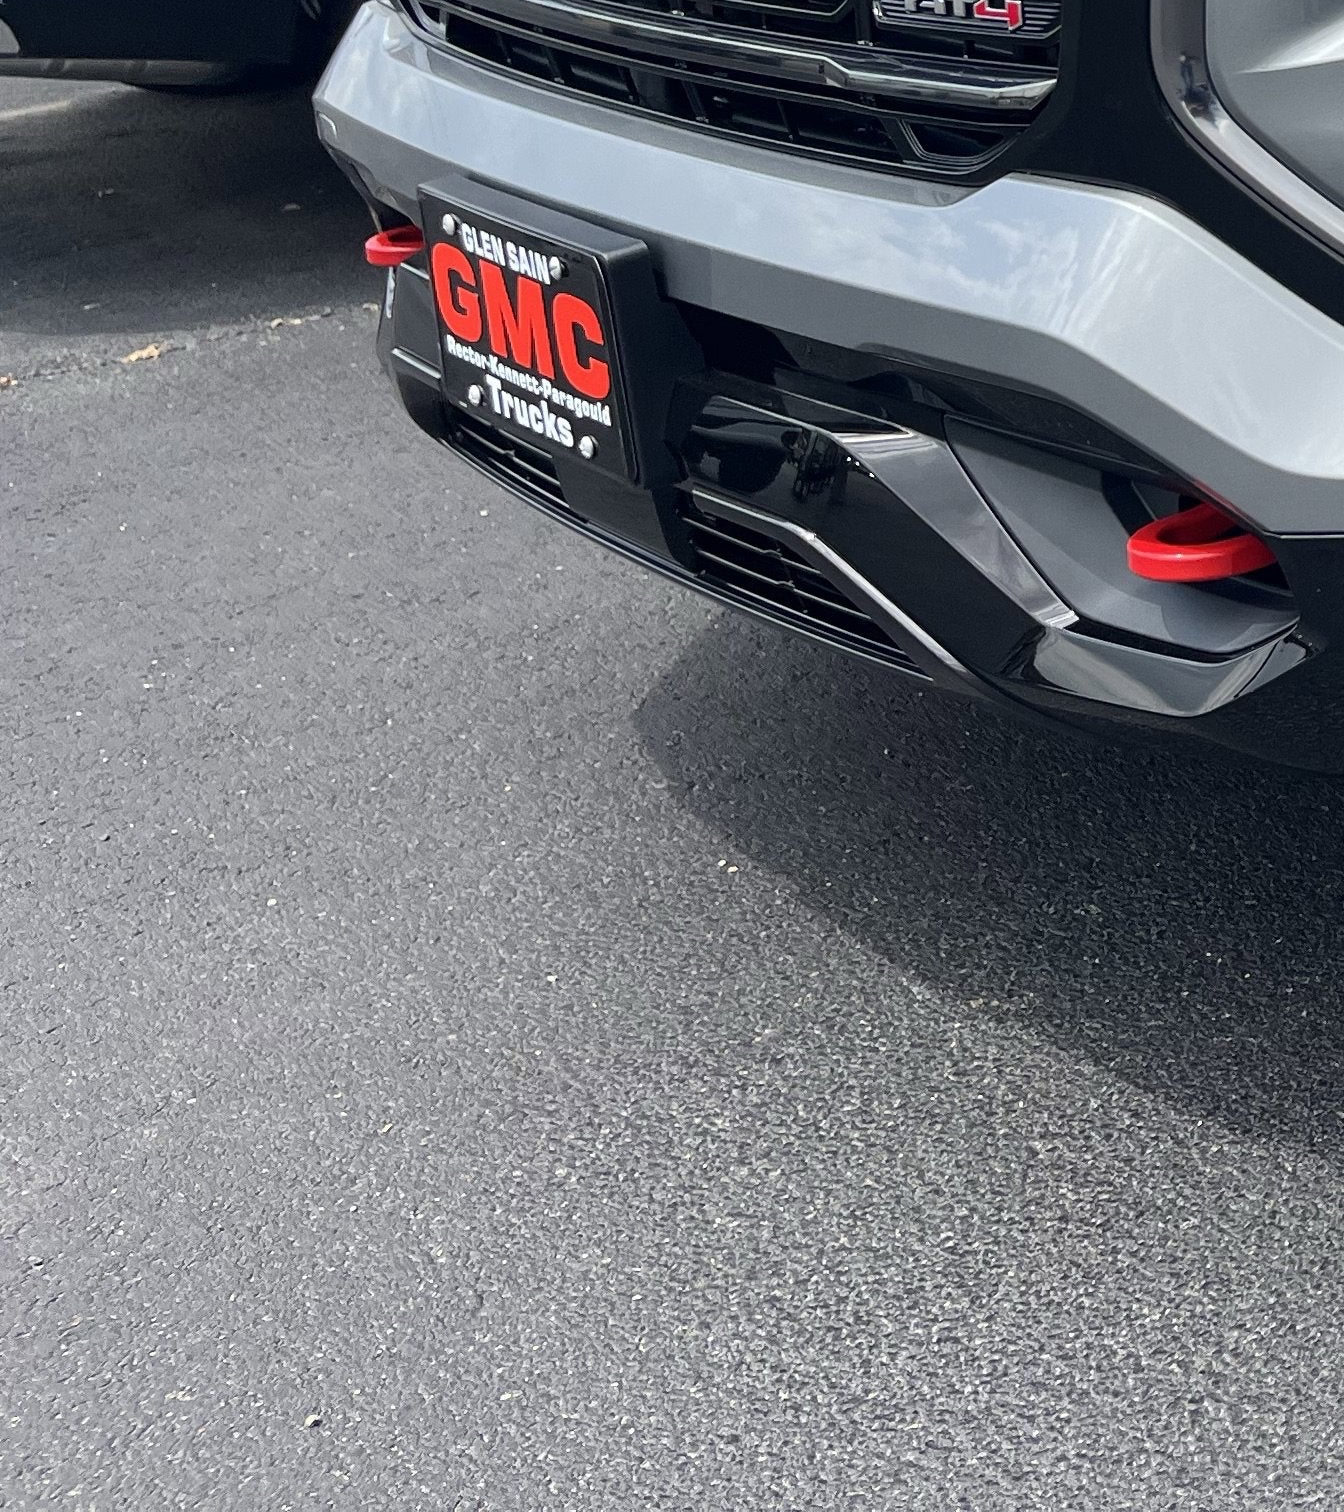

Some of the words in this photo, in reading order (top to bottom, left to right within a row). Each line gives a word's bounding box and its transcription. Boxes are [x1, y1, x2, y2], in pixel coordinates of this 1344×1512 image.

[460, 222, 507, 267] GLEN
[505, 240, 551, 285] SAIN
[432, 242, 611, 400] GMC
[446, 333, 612, 427] Rector-Kennett-Paragould
[485, 373, 574, 448] Trucks
